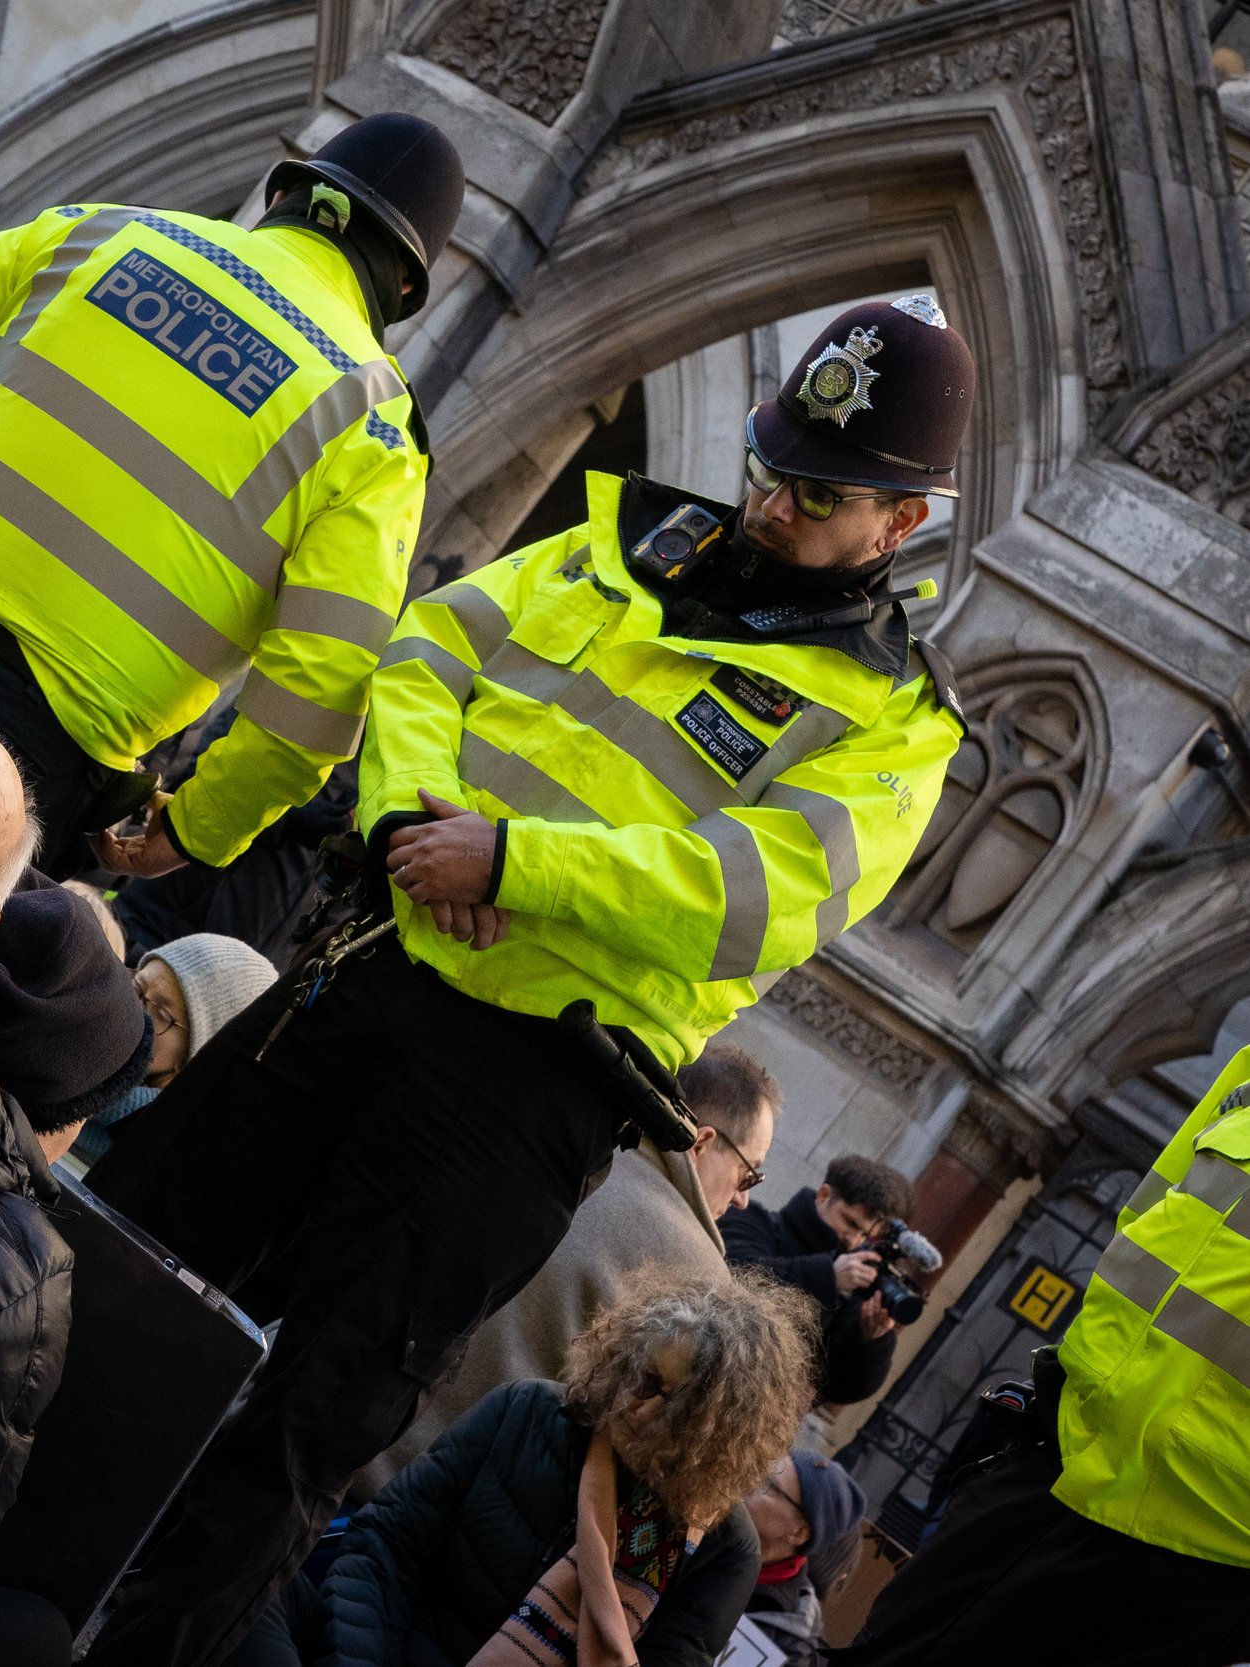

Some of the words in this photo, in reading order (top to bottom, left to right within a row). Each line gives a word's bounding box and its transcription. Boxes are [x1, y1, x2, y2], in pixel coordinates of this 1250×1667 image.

[92, 268, 275, 410] POLICE
[122, 253, 293, 379] METROPOLITAN
[681, 714, 712, 743] POLICE
[708, 741, 744, 775] OFFICER
[715, 726, 746, 754] POLICE
[717, 718, 755, 751] METROPOLITAN
[877, 771, 913, 819] OLICE
